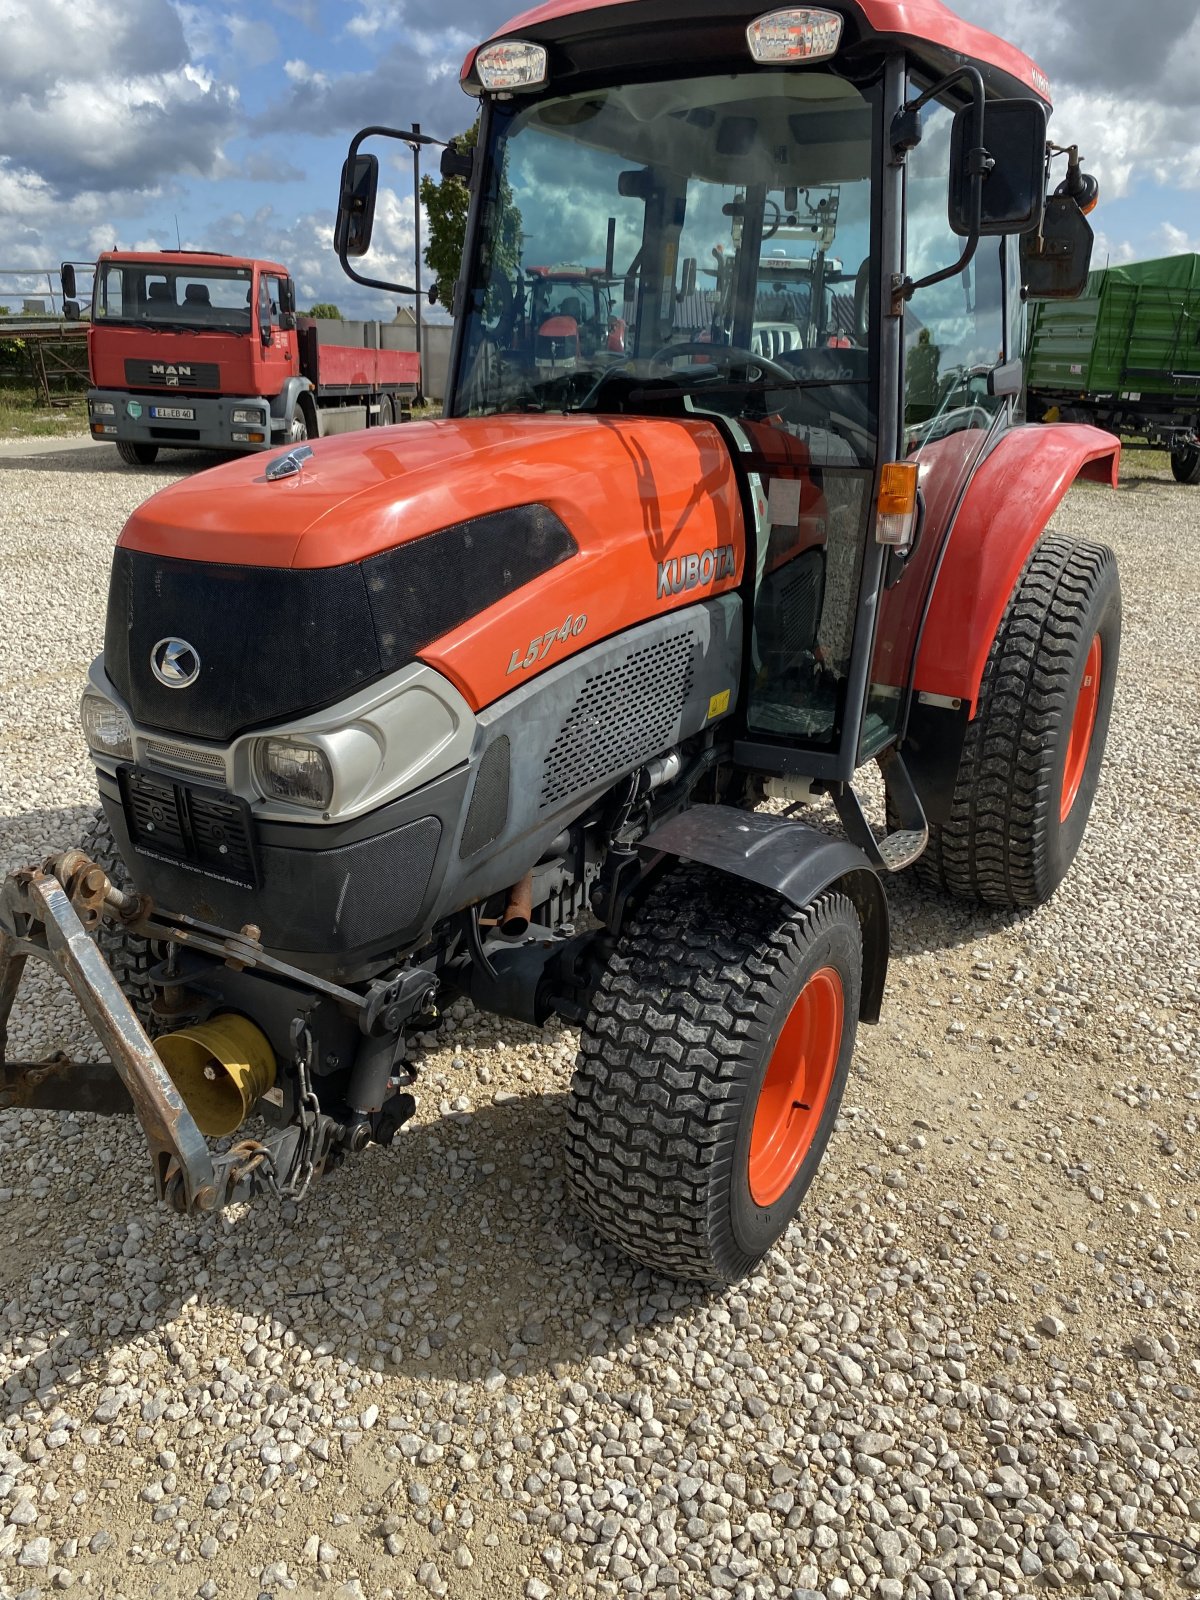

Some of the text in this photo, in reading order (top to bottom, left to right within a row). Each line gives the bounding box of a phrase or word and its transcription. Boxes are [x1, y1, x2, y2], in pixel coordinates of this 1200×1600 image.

[767, 259, 791, 267] STEYR
[152, 364, 191, 375] MAN
[656, 545, 736, 599] KUBOTA
[506, 614, 588, 676] L5740
